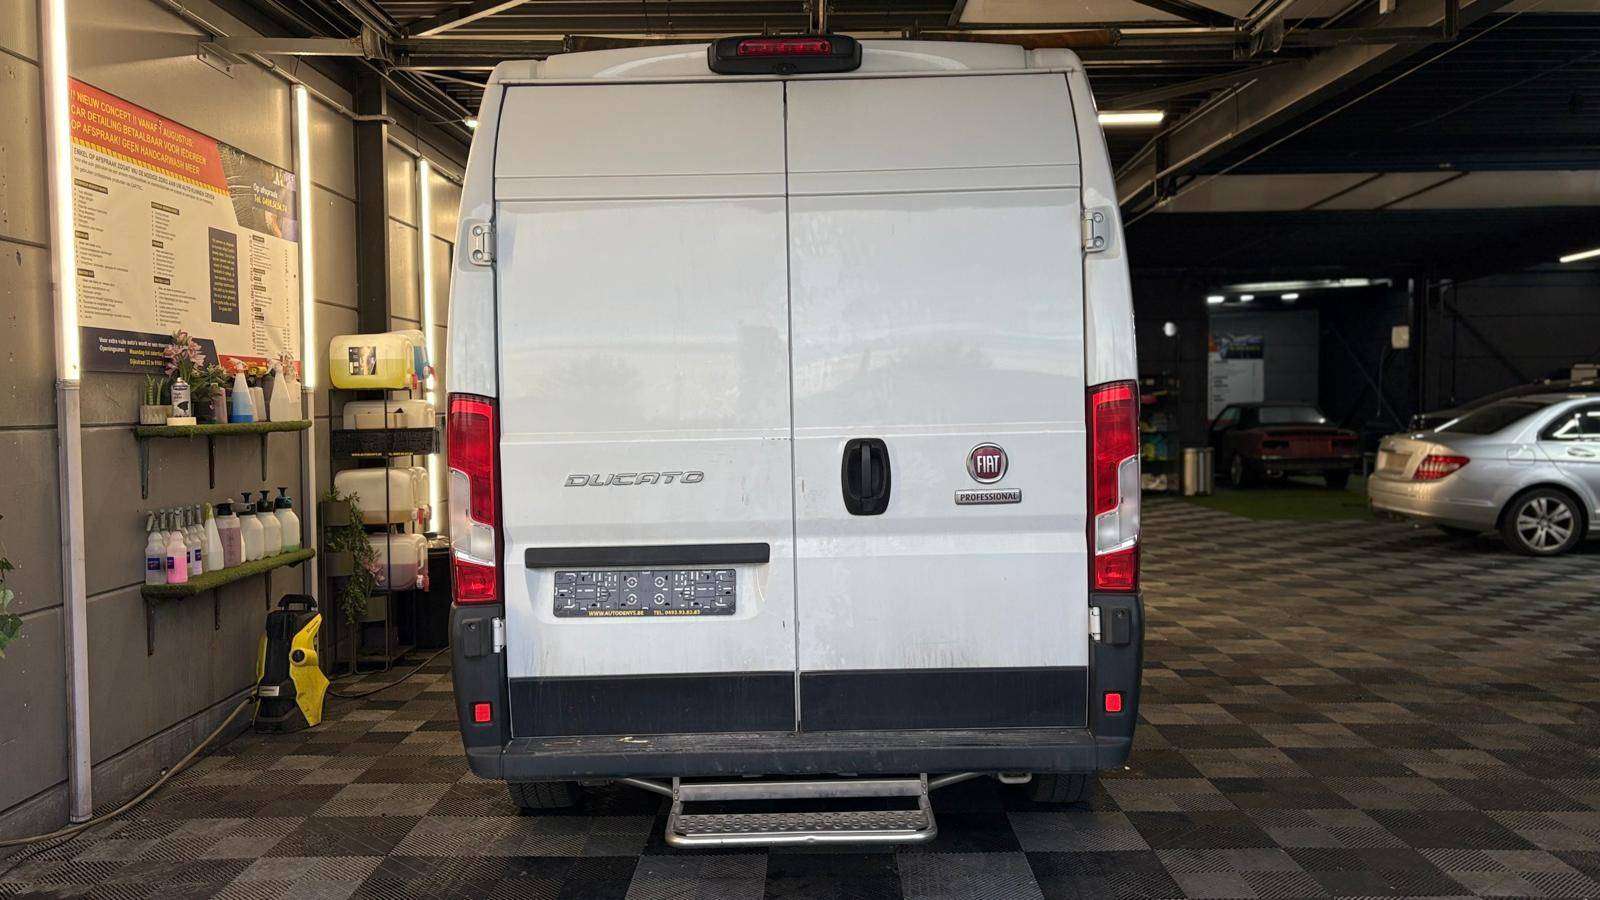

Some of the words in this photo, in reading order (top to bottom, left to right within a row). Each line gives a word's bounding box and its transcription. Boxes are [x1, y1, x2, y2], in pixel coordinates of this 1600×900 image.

[71, 104, 86, 120] CAR
[87, 110, 122, 132] DETAILING
[122, 124, 163, 148] BETAALBAAR
[164, 142, 180, 154] VOOR
[180, 148, 208, 166] IEDEREEN
[76, 90, 100, 109] NIEUW
[100, 102, 131, 123] CONCEPT
[138, 118, 158, 132] VANAF
[163, 128, 192, 147] AUGUSTUS
[71, 119, 82, 130] OP
[122, 138, 140, 152] GEEN
[185, 162, 200, 176] MEER
[564, 470, 704, 488] DUCATO
[976, 456, 1000, 473] FIAT
[960, 492, 1018, 502] PROFESSIONAL
